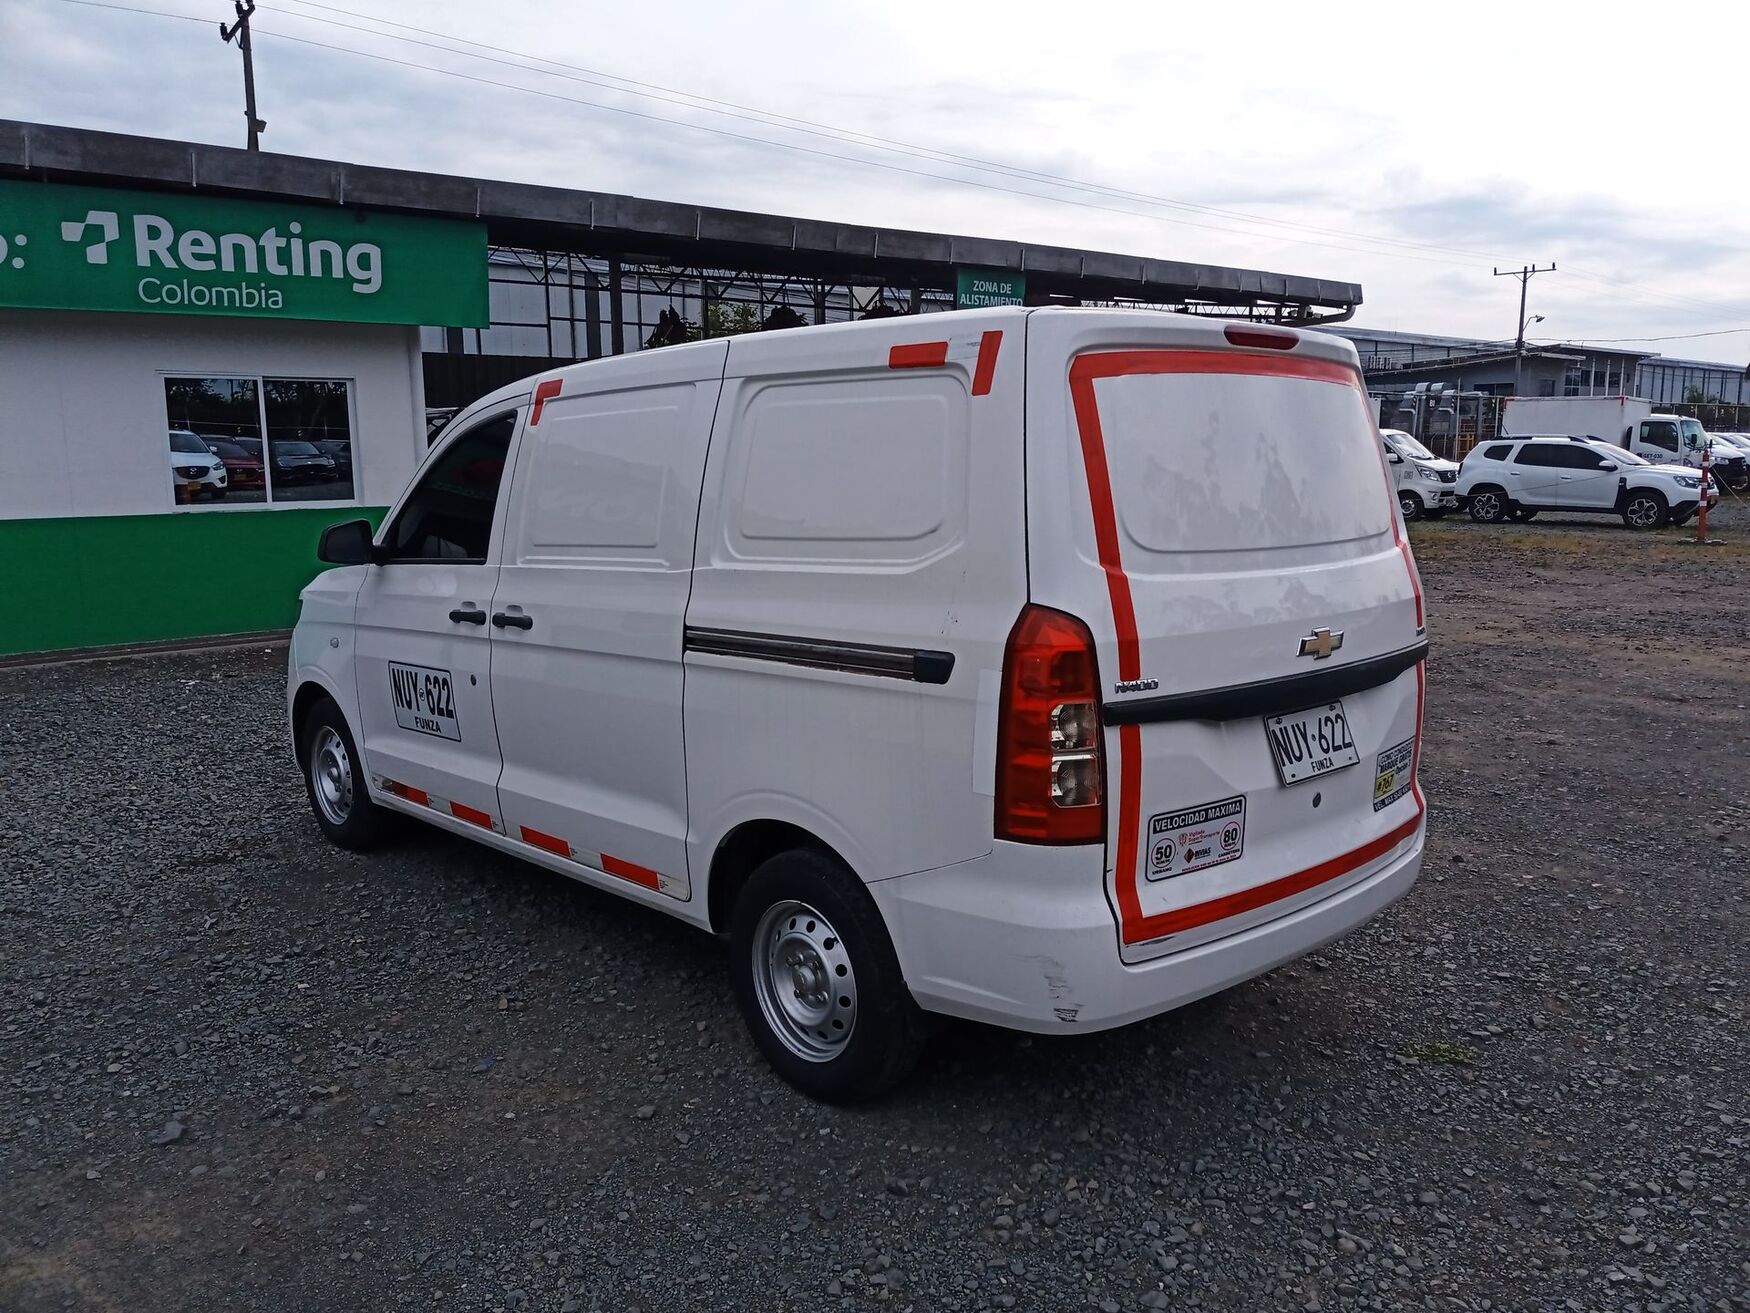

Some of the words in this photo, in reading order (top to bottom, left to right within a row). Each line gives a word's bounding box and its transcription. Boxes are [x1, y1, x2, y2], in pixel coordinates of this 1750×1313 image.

[133, 214, 382, 294] Renting
[138, 277, 283, 309] Colombia
[973, 280, 998, 293] ZONA
[1000, 283, 1012, 294] DE
[960, 293, 1023, 307] ALISTAMIENTO
[414, 716, 442, 733] FUNZA
[1310, 757, 1335, 773] FUNZA
[1155, 811, 1206, 831] VELOCIDAD
[1208, 802, 1241, 819] MAXIMA
[1223, 828, 1238, 843] 80
[1155, 845, 1172, 860] 50
